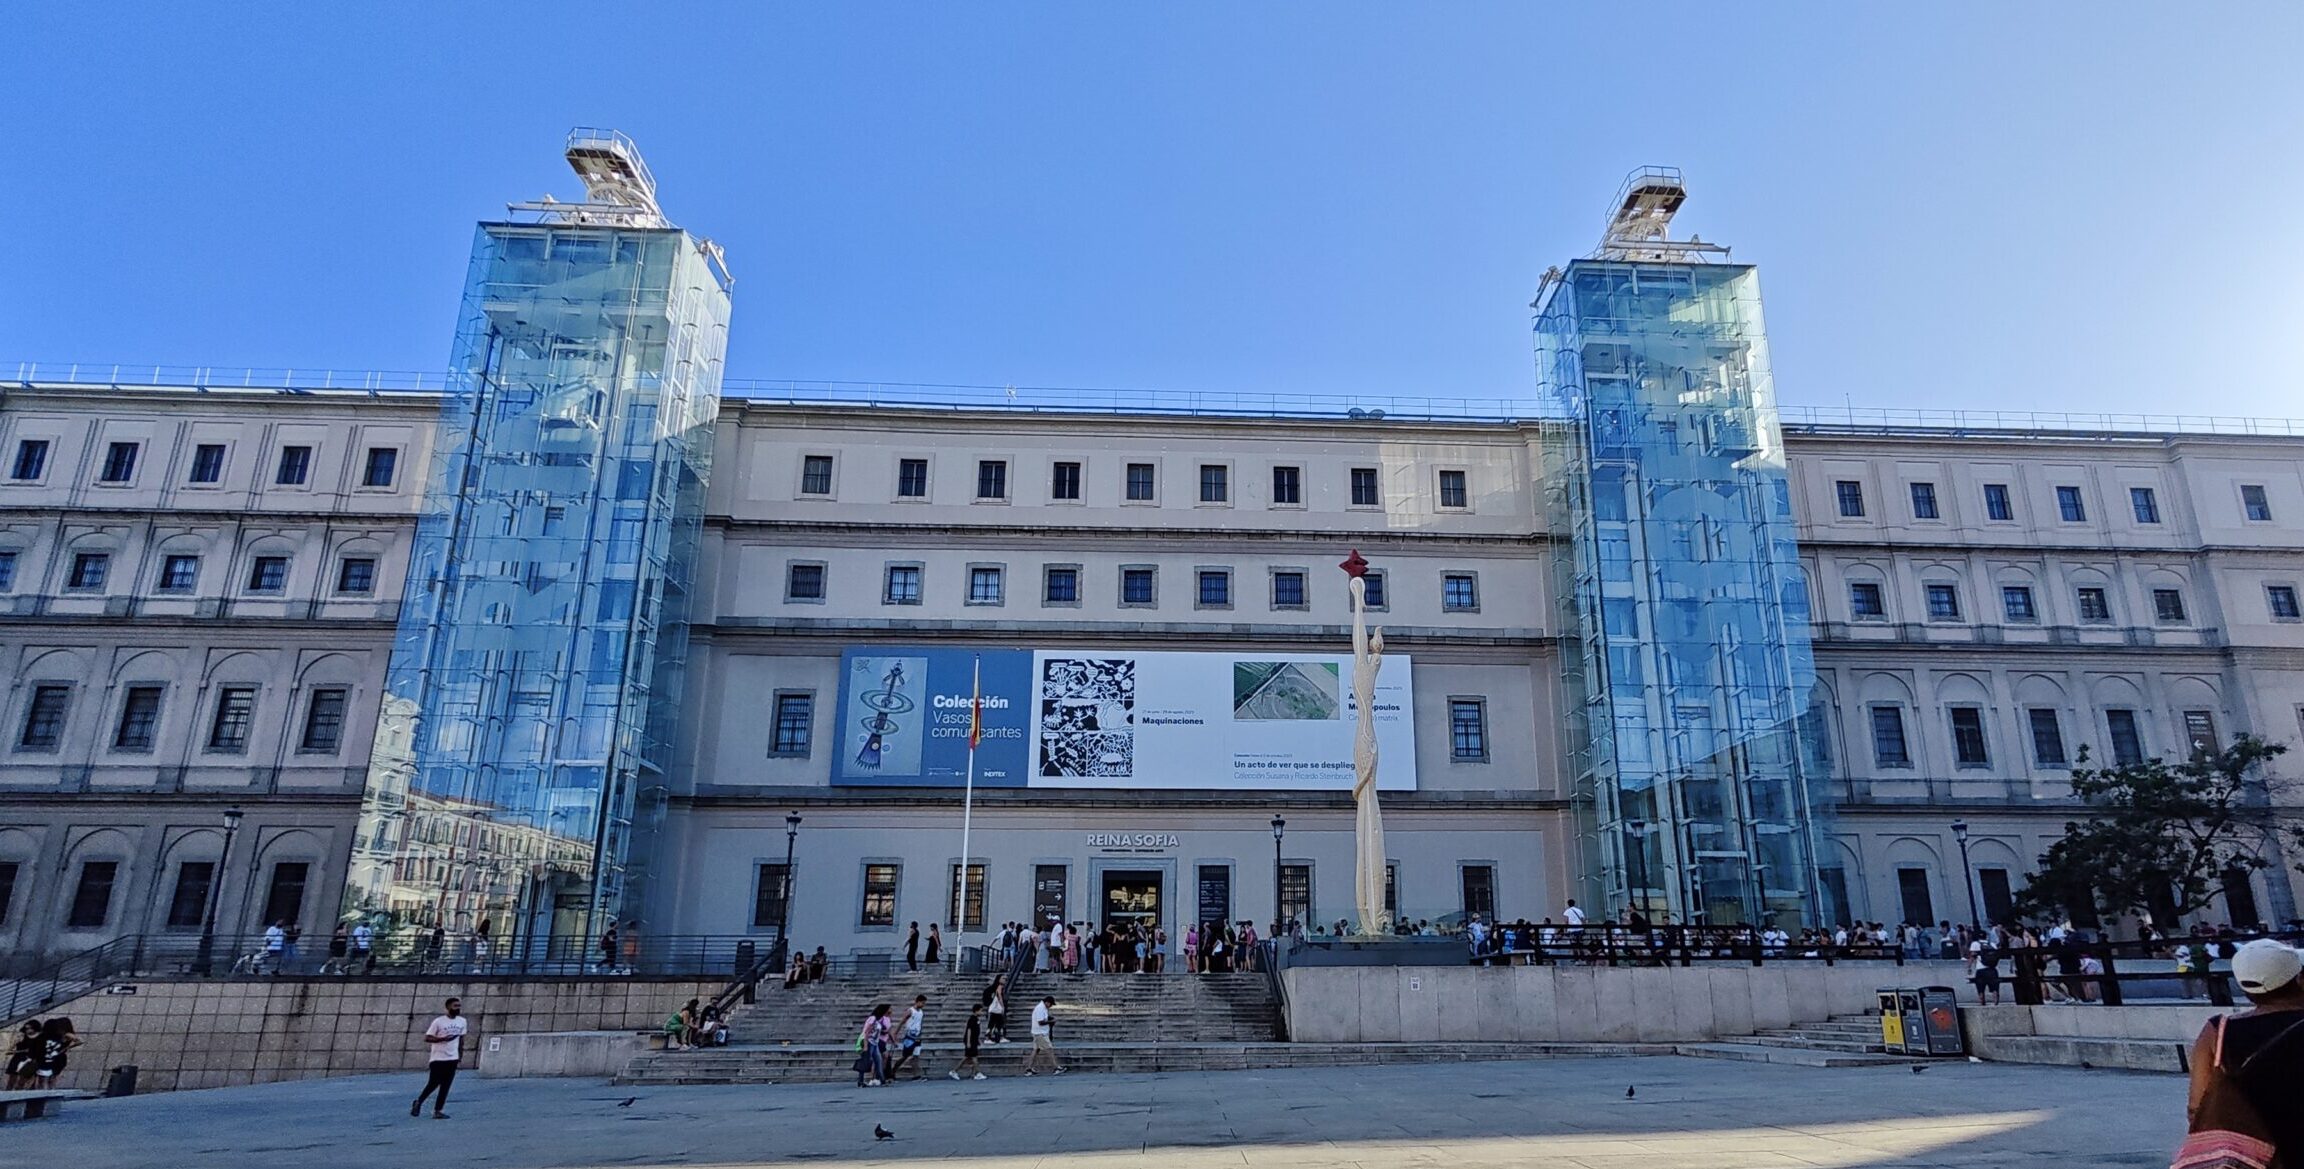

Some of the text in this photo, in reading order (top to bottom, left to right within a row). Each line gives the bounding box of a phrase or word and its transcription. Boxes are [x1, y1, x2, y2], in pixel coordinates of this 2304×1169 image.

[933, 694, 1009, 709] Colección
[1348, 703, 1400, 712] Mpoulos
[933, 710, 972, 724] Vasos
[1142, 716, 1204, 726] Maquinaciones
[1234, 760, 1246, 768] Un
[1293, 762, 1309, 770] que
[1321, 761, 1356, 770] desplieg
[1086, 834, 1132, 846] REINA
